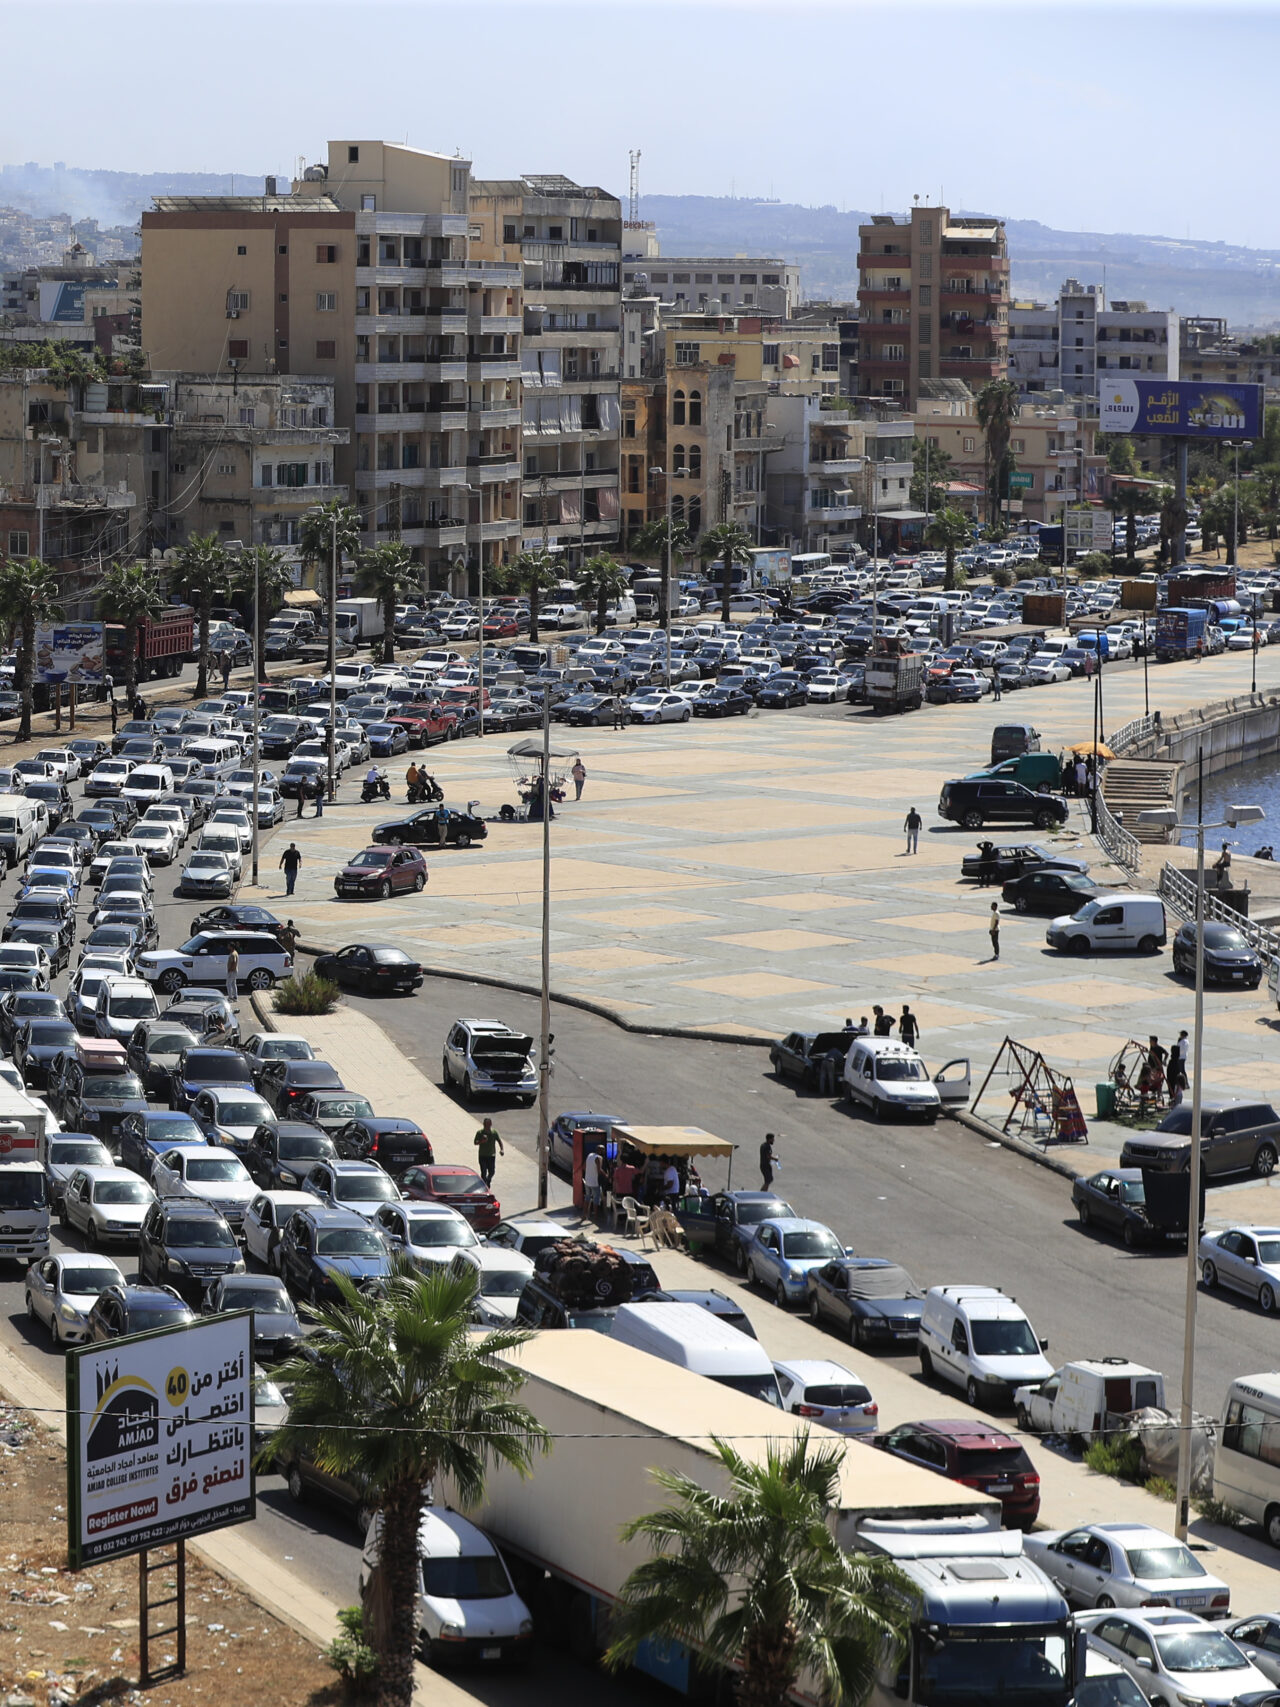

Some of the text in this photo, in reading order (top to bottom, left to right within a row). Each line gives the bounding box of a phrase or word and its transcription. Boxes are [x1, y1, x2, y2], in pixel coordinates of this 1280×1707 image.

[167, 1373, 187, 1396] 40
[191, 1371, 213, 1397] من
[1243, 1385, 1264, 1399] FUSO
[166, 1392, 244, 1437] اختصاص
[166, 1426, 244, 1467] بانتظارك
[87, 1480, 105, 1493] AMJAD
[106, 1473, 128, 1489] COLLEGE
[129, 1465, 159, 1481] INSTITUTES
[165, 1472, 198, 1505] فرق
[202, 1458, 244, 1495] لنصنع
[88, 1501, 156, 1531] Register Now!
[93, 1545, 103, 1555] 03
[103, 1541, 115, 1552] 032
